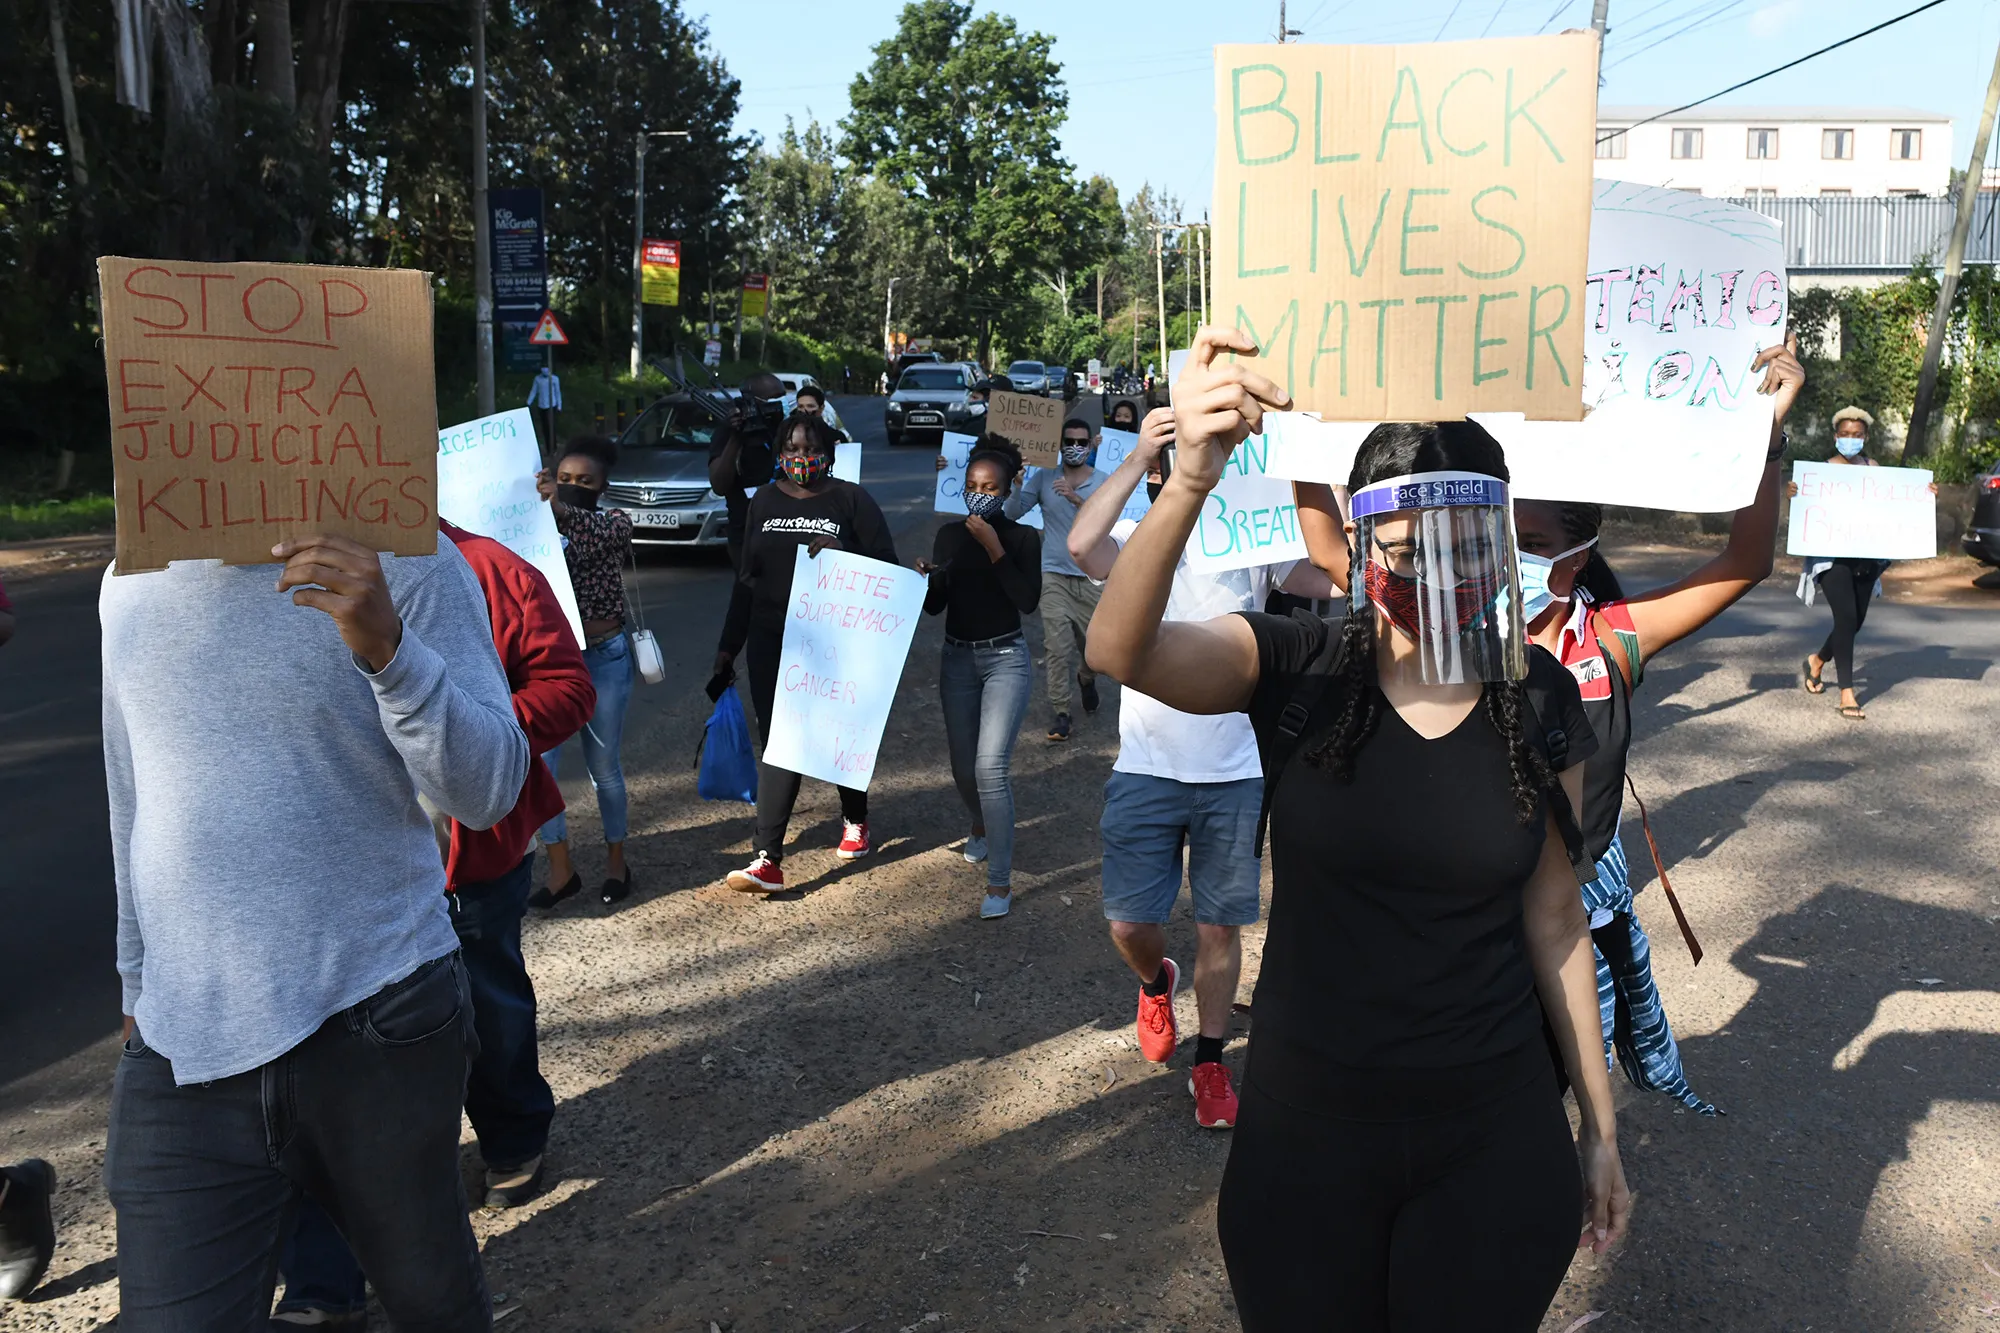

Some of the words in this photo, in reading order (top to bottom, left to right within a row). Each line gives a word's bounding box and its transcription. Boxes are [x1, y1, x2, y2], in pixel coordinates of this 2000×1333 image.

[1231, 62, 1568, 167] BLACK
[495, 208, 513, 220] Kip
[495, 217, 538, 229] McGrath
[1237, 181, 1528, 279] LIVES
[124, 265, 369, 341] STOP
[1229, 283, 1572, 401] MATTER
[118, 358, 378, 418] EXTRA
[995, 395, 1055, 418] SILENCE
[481, 416, 517, 445] FOR
[1001, 417, 1042, 432] SUPPORTS
[117, 420, 412, 467] JUDICIAL
[1010, 438, 1058, 453] OLENCE
[137, 475, 430, 533] KILLINGS
[1391, 486, 1428, 501] Face
[1433, 480, 1484, 496] Shield
[1394, 500, 1415, 508] Direct
[1416, 497, 1441, 507] Splash
[1443, 496, 1483, 504] Proctection
[479, 500, 540, 525] OMONDI
[817, 557, 895, 599] WHITE
[796, 593, 905, 636] SUPREMACY
[825, 645, 838, 664] a
[784, 664, 857, 704] CANCER
